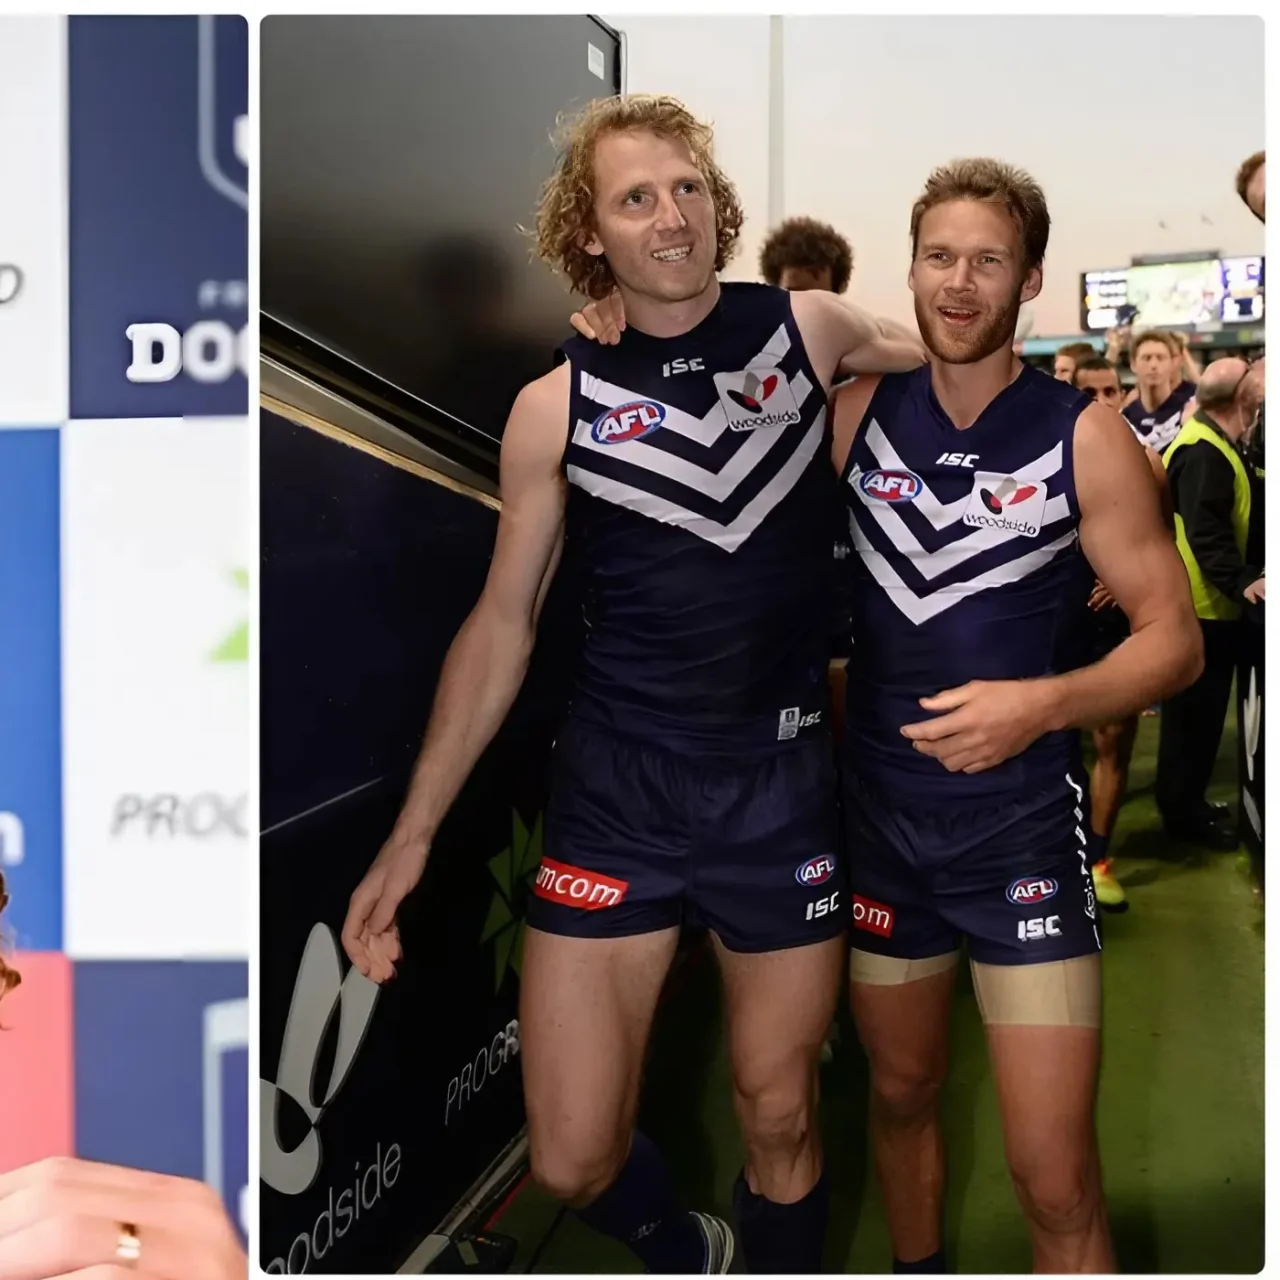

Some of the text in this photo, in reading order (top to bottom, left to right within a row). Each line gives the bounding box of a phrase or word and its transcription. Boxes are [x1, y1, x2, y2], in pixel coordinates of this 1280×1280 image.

[663, 357, 705, 378] ISC
[598, 406, 662, 442] AFL
[935, 452, 980, 468] ISC
[863, 474, 918, 497] AFL
[802, 859, 835, 882] AFL
[1013, 879, 1054, 901] AFL
[805, 891, 839, 921] ISC
[1017, 915, 1062, 941] ISC
